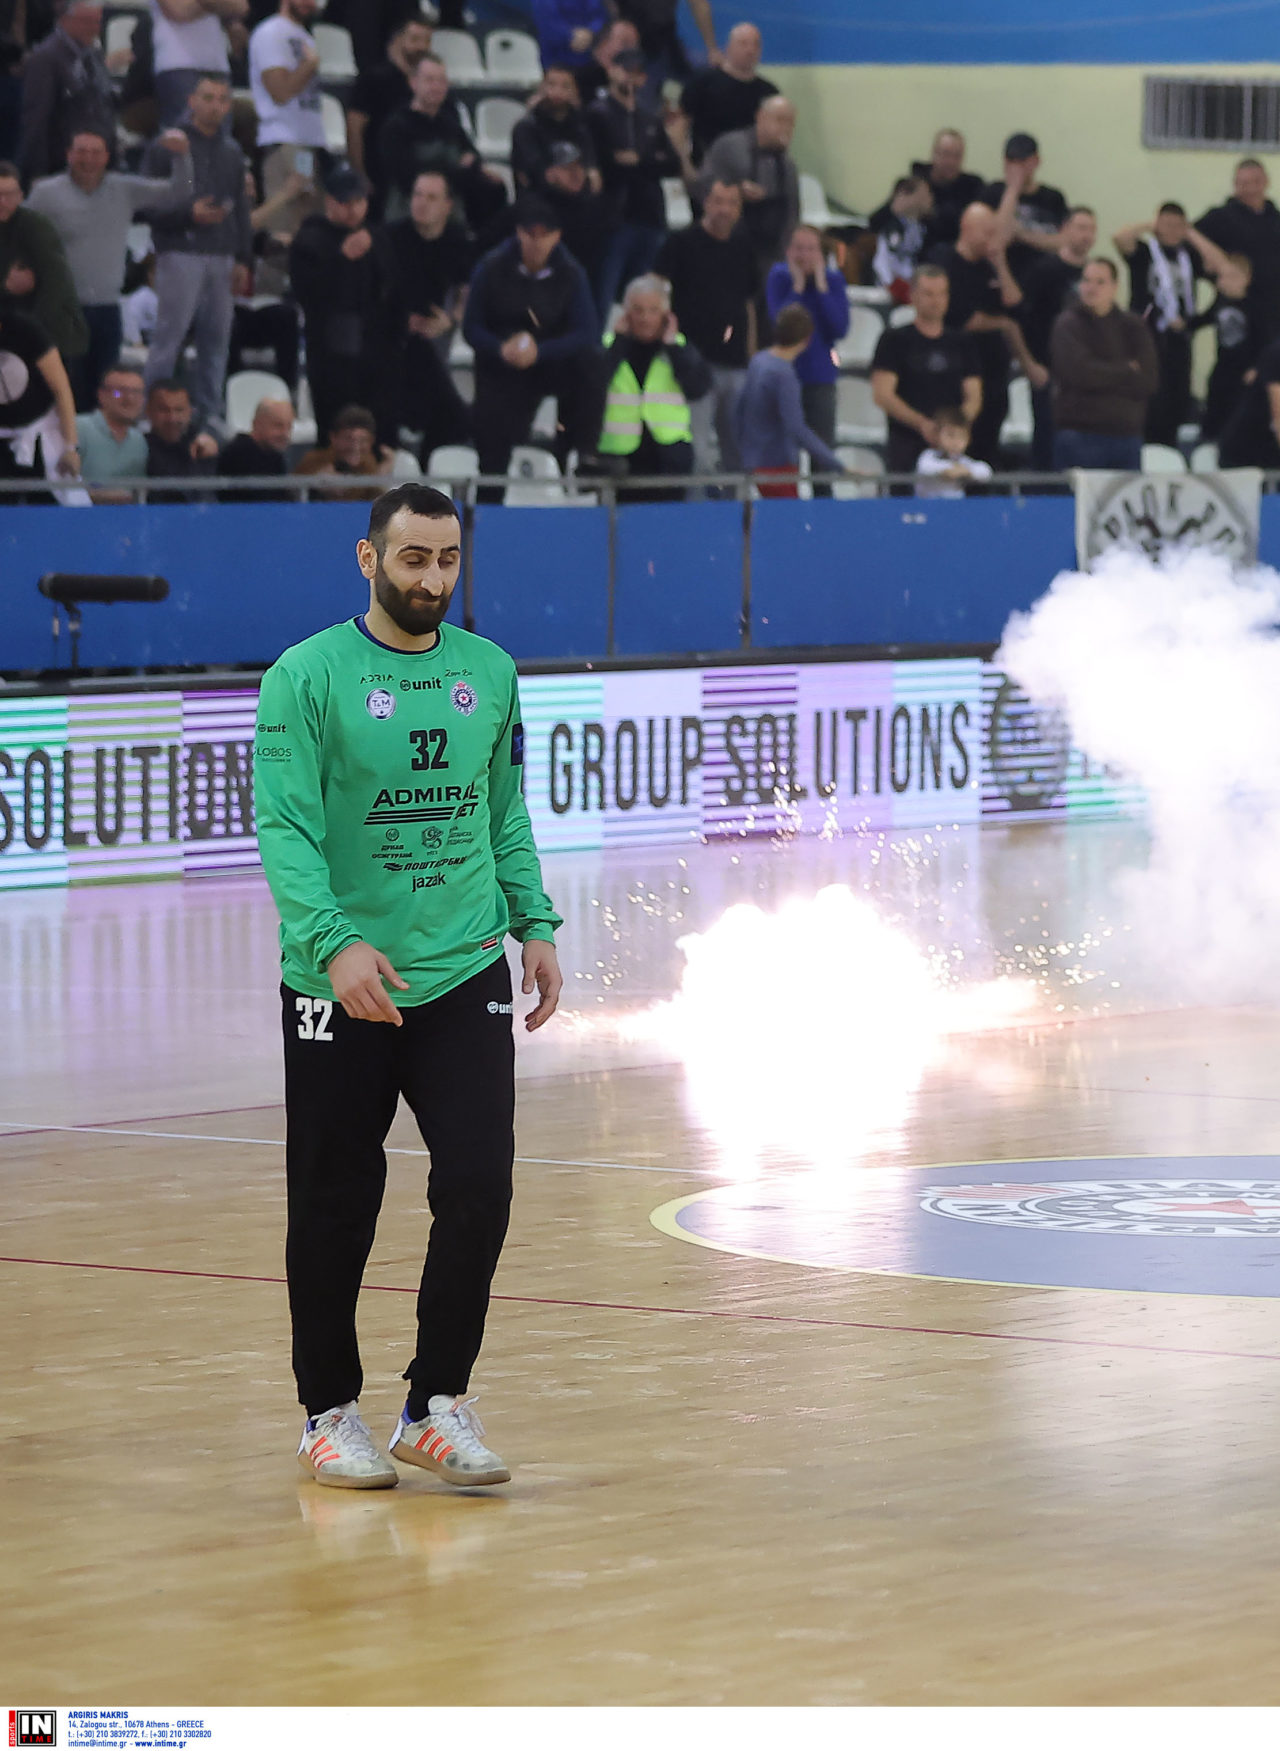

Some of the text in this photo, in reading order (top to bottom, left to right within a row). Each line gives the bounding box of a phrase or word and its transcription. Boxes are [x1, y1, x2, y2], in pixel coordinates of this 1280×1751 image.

[412, 677, 442, 691] unit
[409, 728, 449, 771] 32
[550, 701, 971, 814] GROUP SOLUTIONS
[411, 871, 447, 893] jazak
[295, 997, 333, 1041] 32
